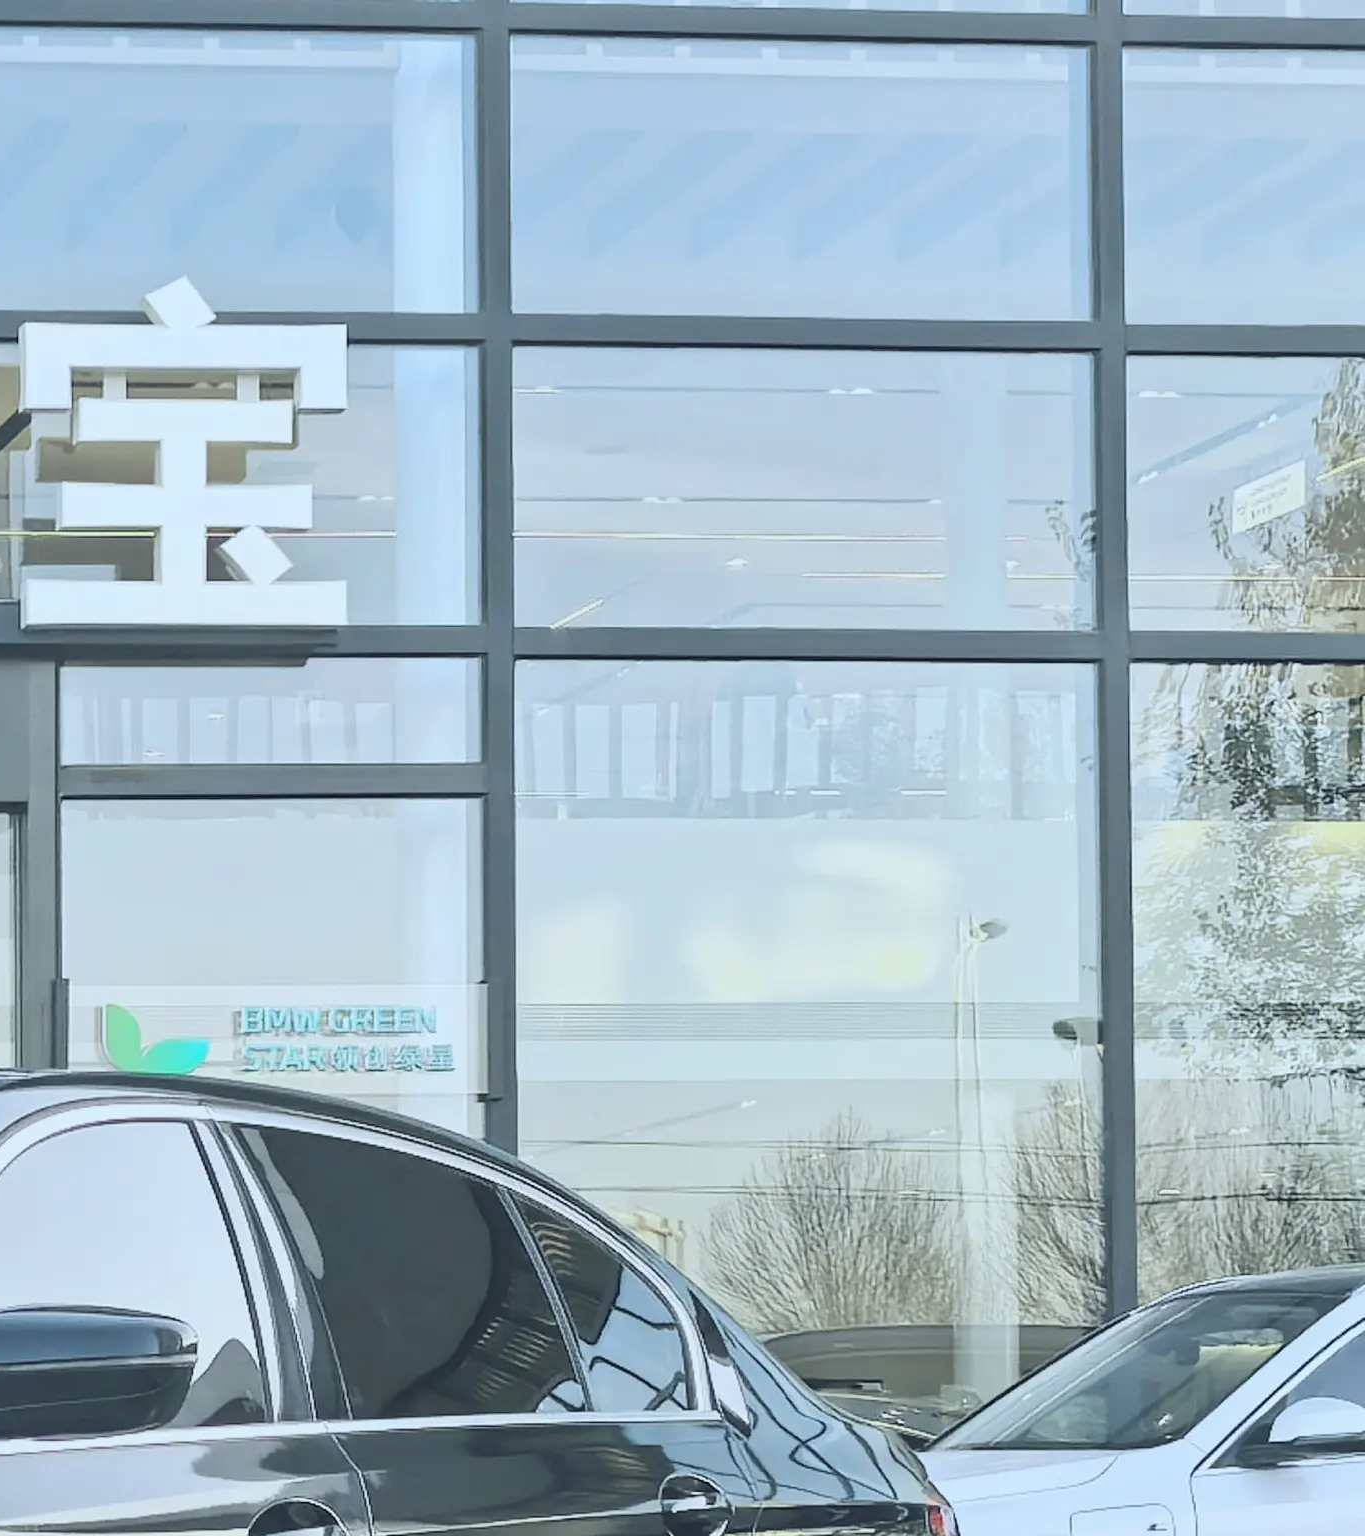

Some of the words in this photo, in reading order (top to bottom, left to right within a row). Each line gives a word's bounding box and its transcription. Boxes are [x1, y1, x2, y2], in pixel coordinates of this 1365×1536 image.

[241, 1007, 320, 1033] BMW
[329, 1007, 437, 1033] GREEN
[242, 1044, 326, 1071] STAR
